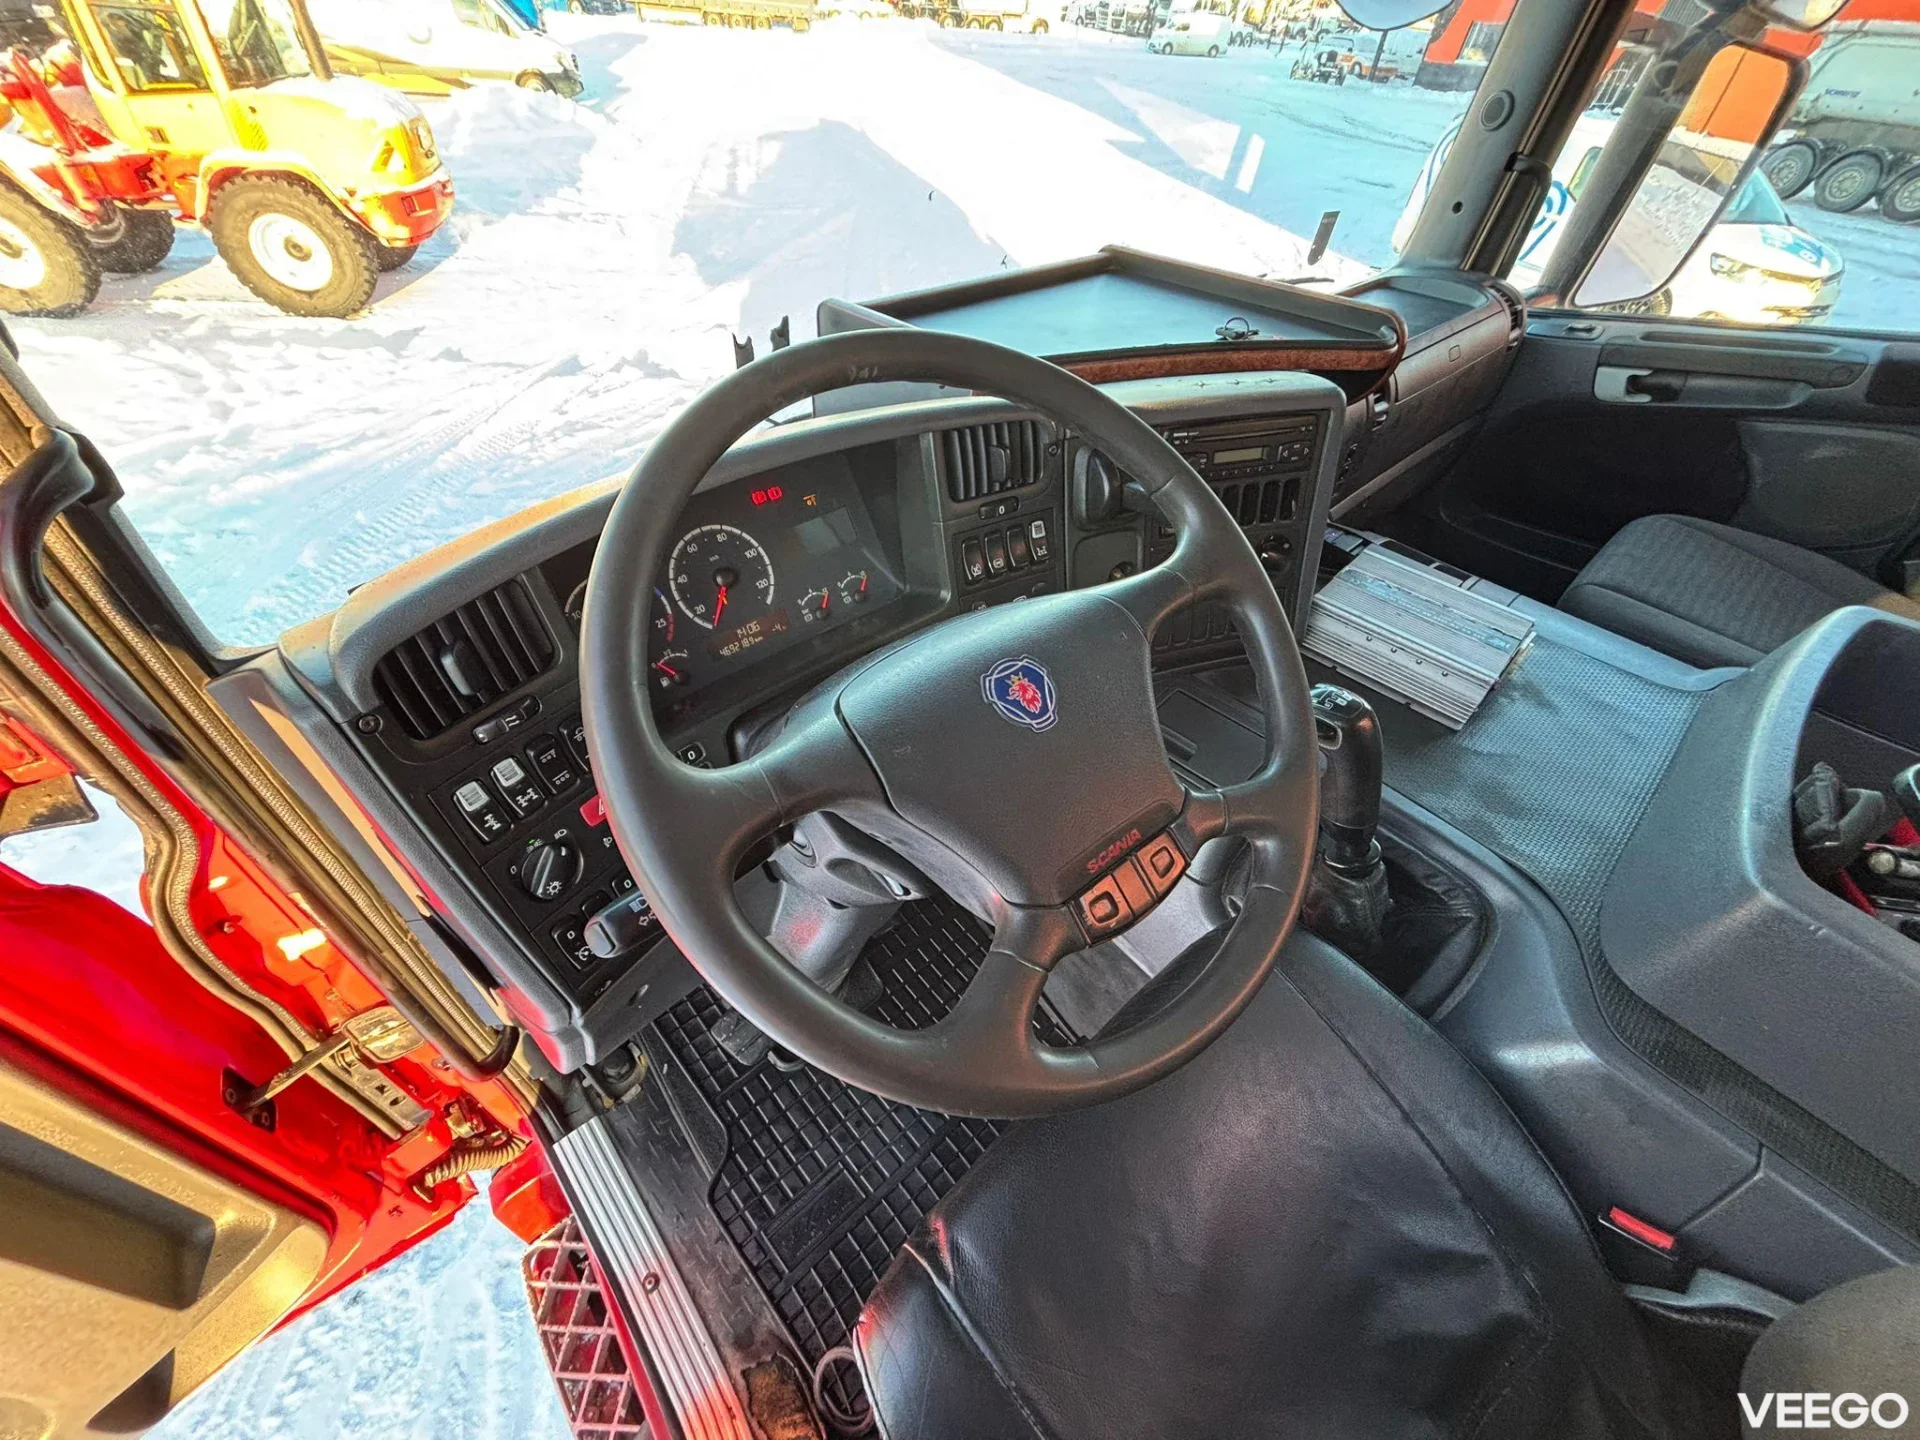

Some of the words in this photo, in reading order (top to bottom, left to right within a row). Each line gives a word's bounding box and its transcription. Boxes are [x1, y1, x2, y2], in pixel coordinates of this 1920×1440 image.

[716, 532, 728, 542] 80
[686, 543, 698, 553] 60
[744, 548, 758, 559] 100
[677, 574, 688, 584] 40
[756, 578, 769, 590] 120
[694, 604, 706, 615] 20
[655, 618, 667, 629] 25
[1086, 828, 1142, 874] SCANIA
